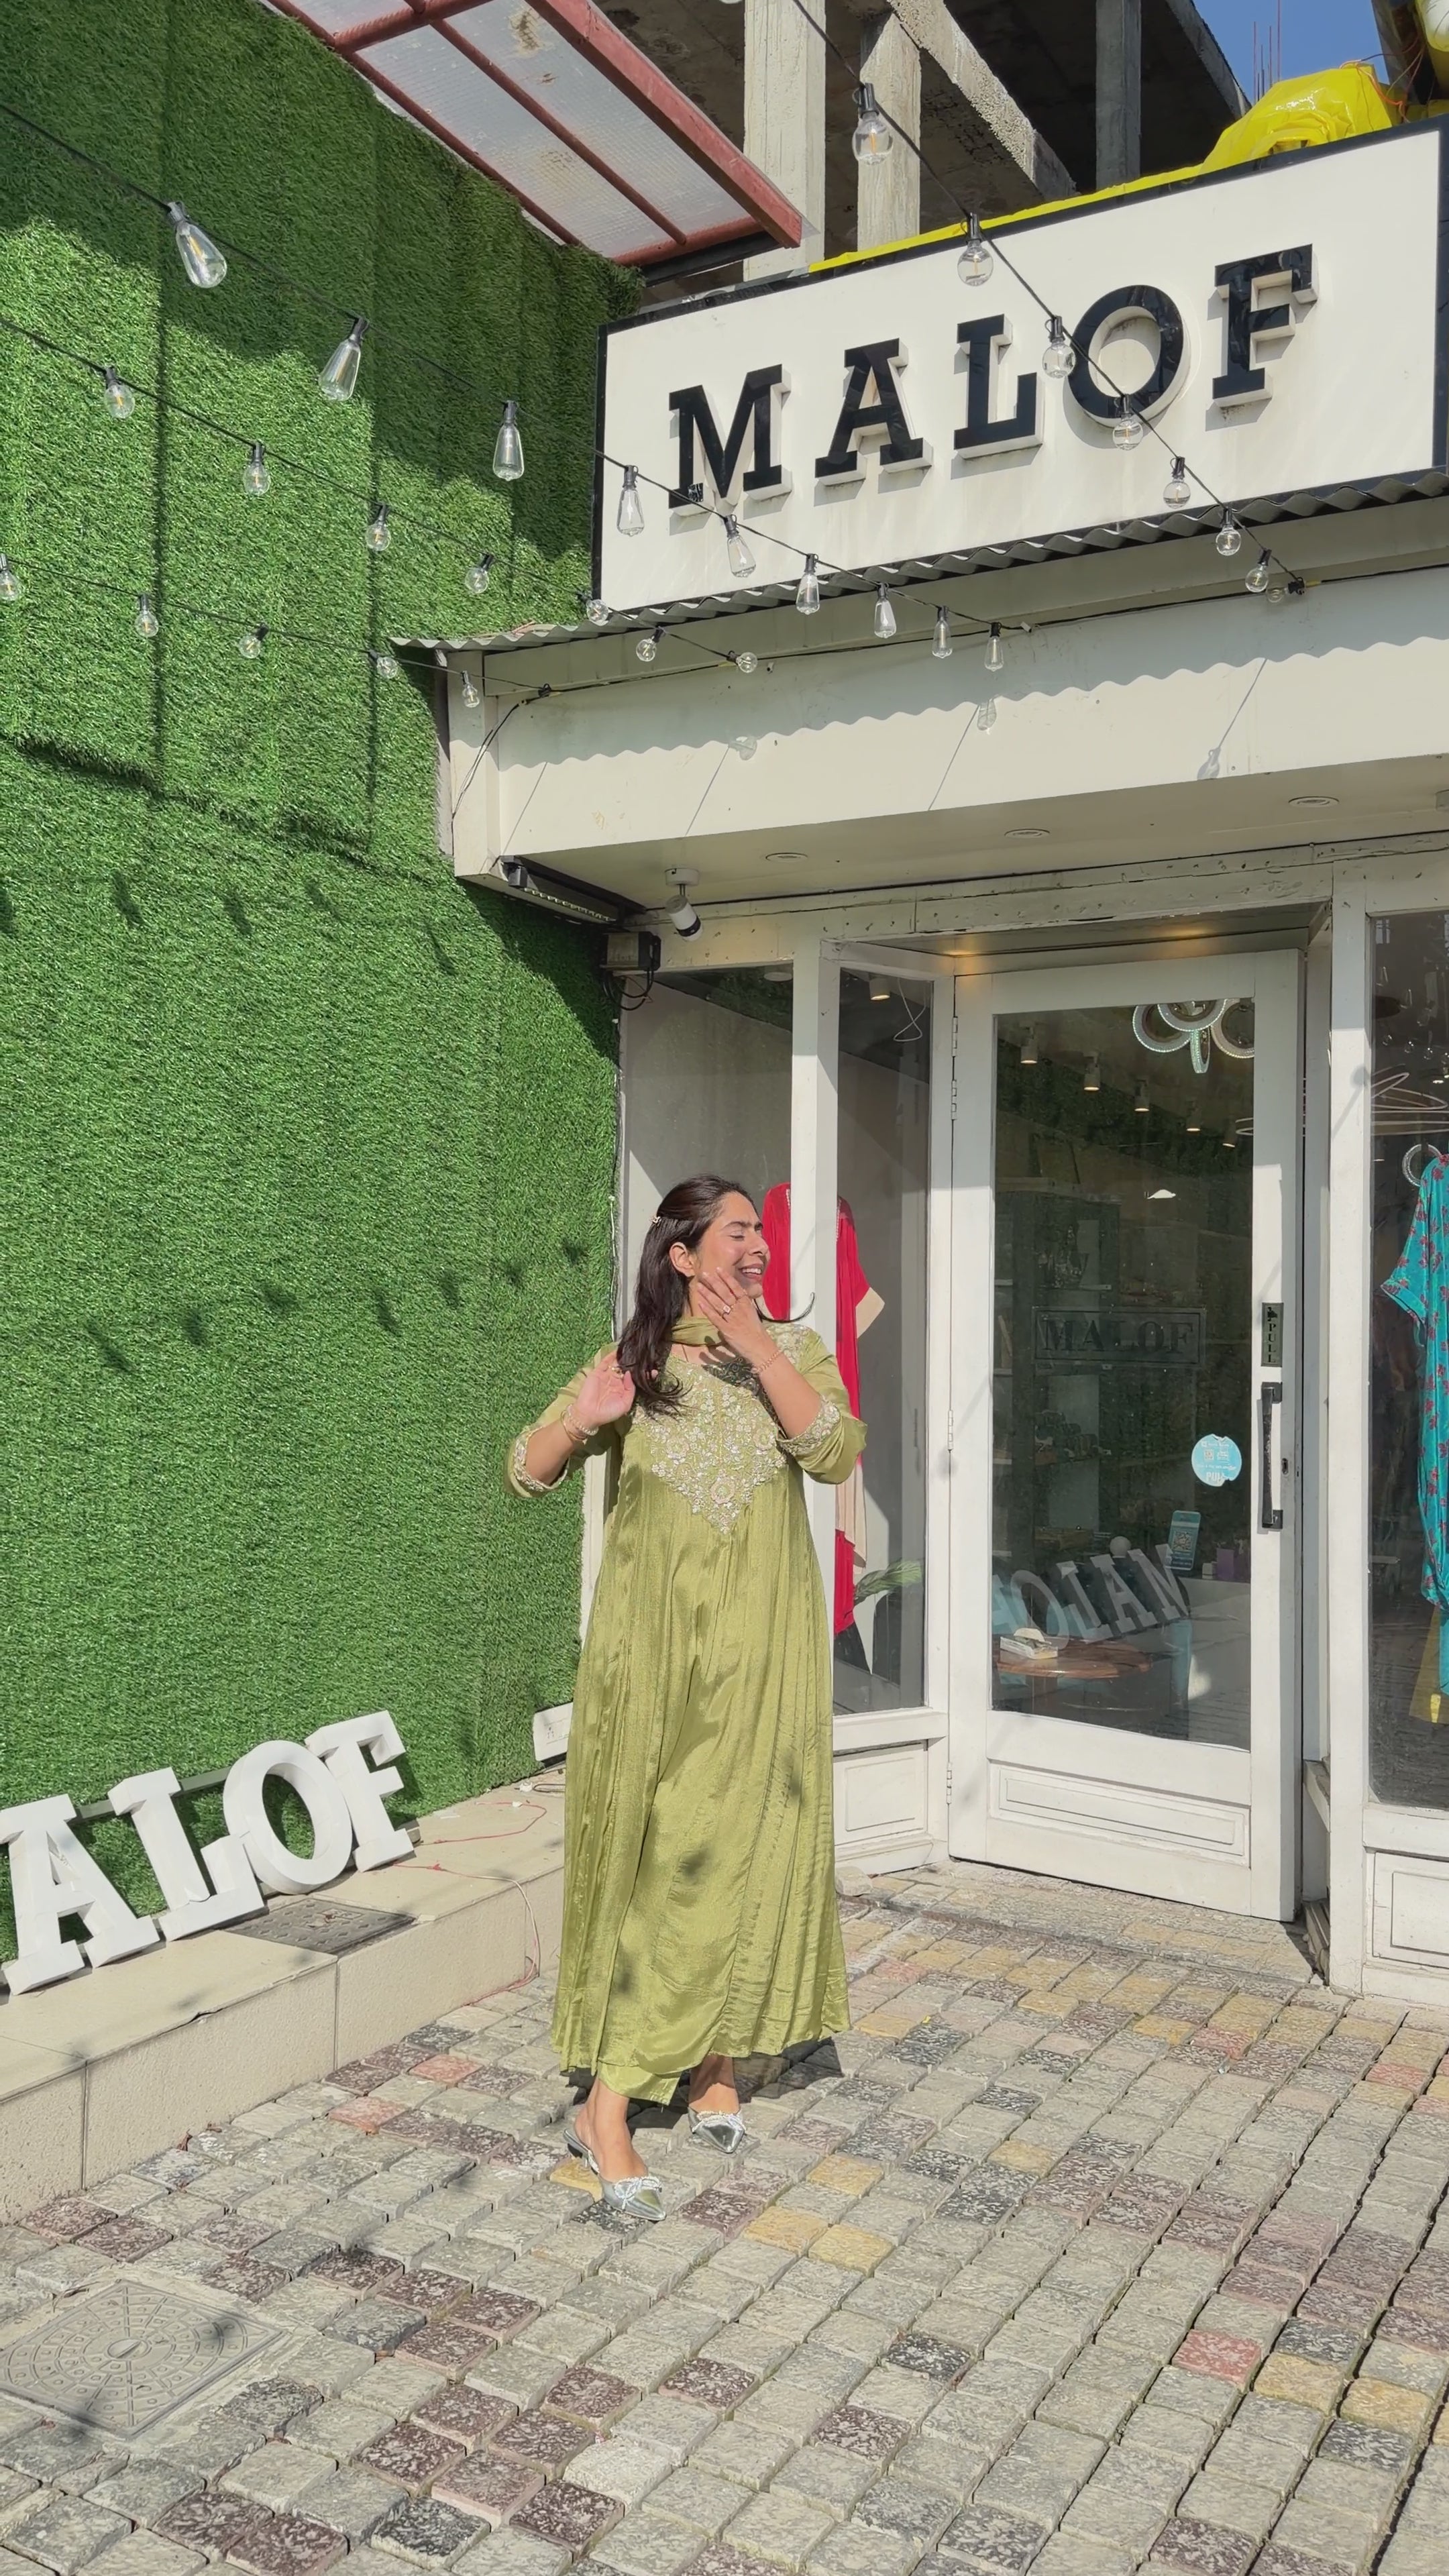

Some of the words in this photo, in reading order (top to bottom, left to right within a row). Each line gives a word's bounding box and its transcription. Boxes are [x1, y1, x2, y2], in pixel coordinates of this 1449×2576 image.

[669, 244, 1315, 512] MALOF
[1040, 1318, 1193, 1354] MALOF
[1267, 1322, 1277, 1363] PULL
[0, 1710, 415, 1995] ALOF
